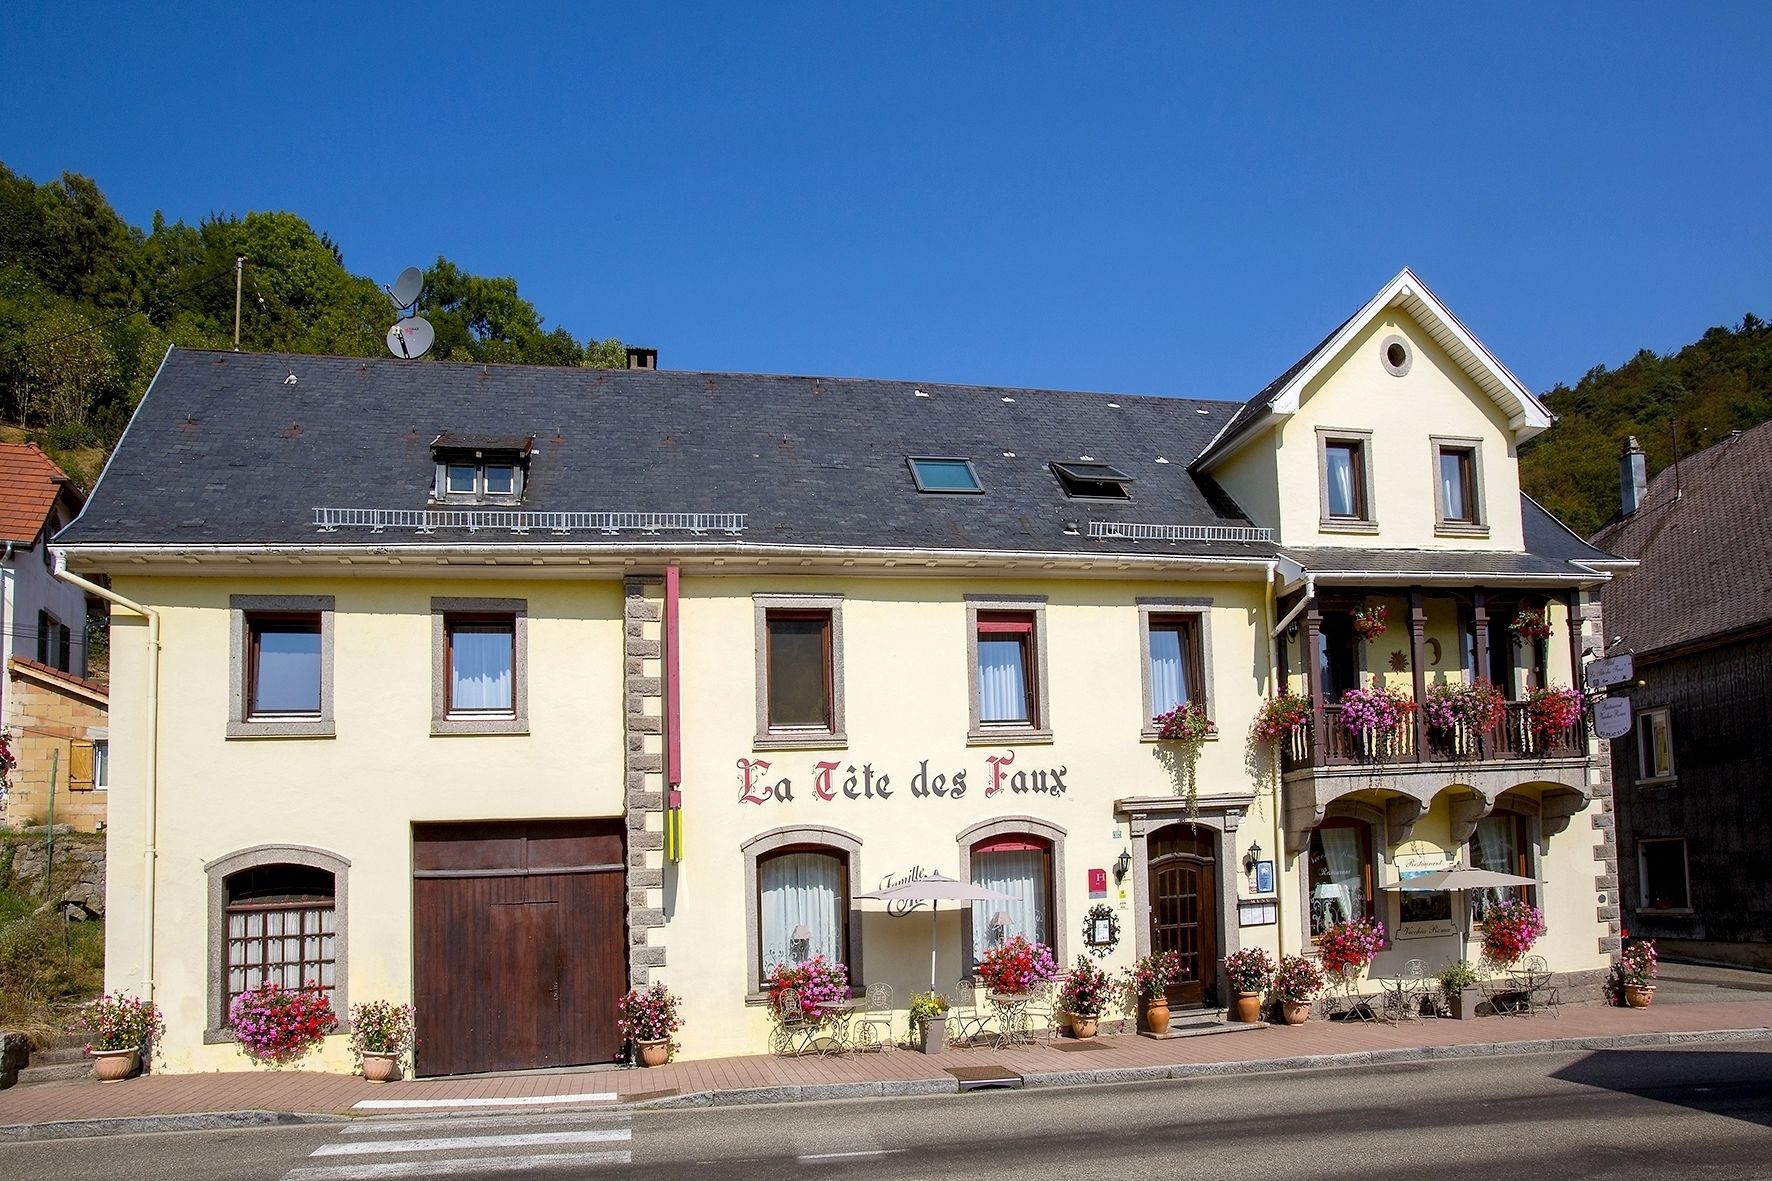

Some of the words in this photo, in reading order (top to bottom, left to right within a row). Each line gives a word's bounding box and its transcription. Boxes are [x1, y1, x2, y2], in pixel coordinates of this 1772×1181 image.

[736, 758, 795, 806] La
[811, 760, 894, 802] Tête
[910, 759, 967, 800] des
[985, 750, 1067, 799] Faux
[1405, 859, 1443, 868] Restaurant
